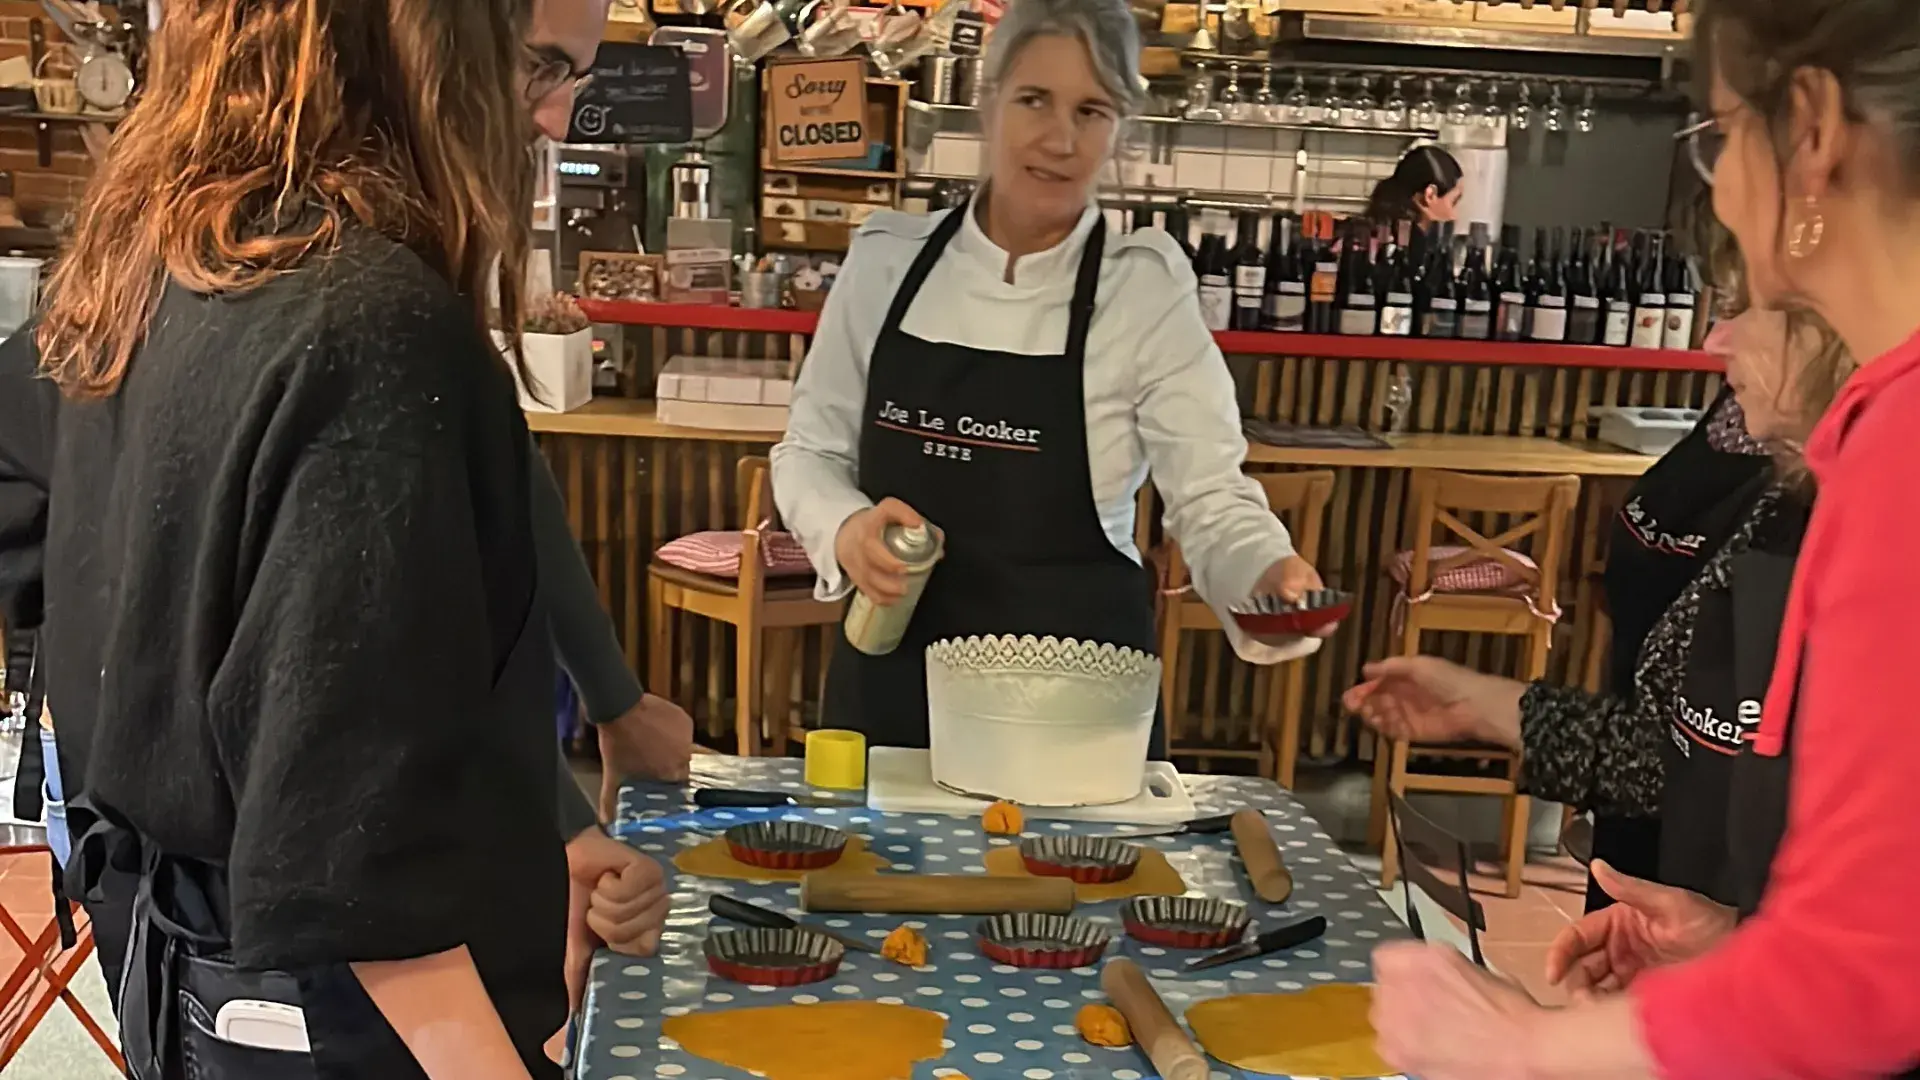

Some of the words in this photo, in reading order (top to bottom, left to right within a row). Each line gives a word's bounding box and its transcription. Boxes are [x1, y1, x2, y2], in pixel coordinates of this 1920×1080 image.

[785, 73, 847, 105] Sorry
[780, 121, 862, 146] CLOSED
[878, 401, 909, 423] Joe
[918, 409, 945, 430] Le
[956, 416, 1041, 443] Cooker
[922, 441, 972, 461] SETE
